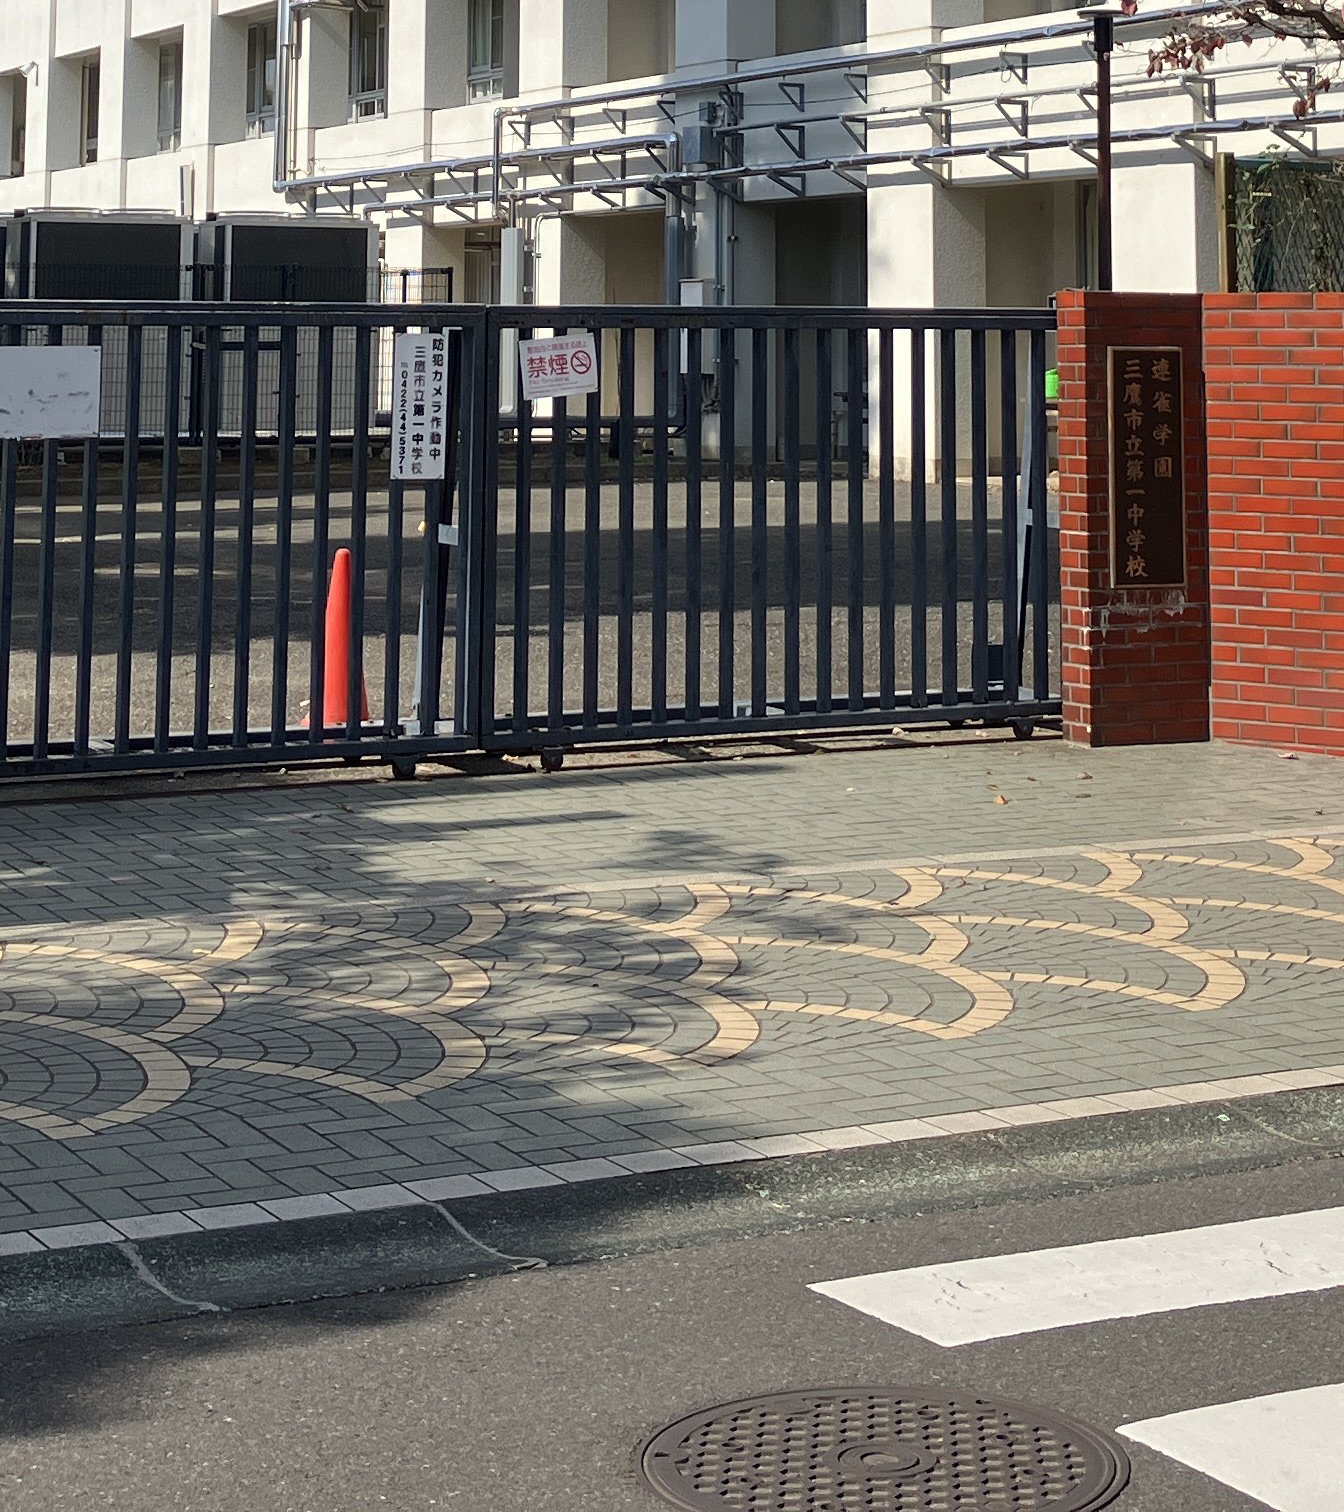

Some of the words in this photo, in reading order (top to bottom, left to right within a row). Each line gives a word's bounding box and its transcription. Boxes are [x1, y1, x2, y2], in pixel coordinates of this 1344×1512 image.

[411, 346, 427, 475] 三鷹市立第一中学校
[429, 338, 444, 460] 防犯カメラ作動中
[527, 353, 570, 379] 禁煙
[1123, 358, 1149, 578] 三鷹市立第一中学校
